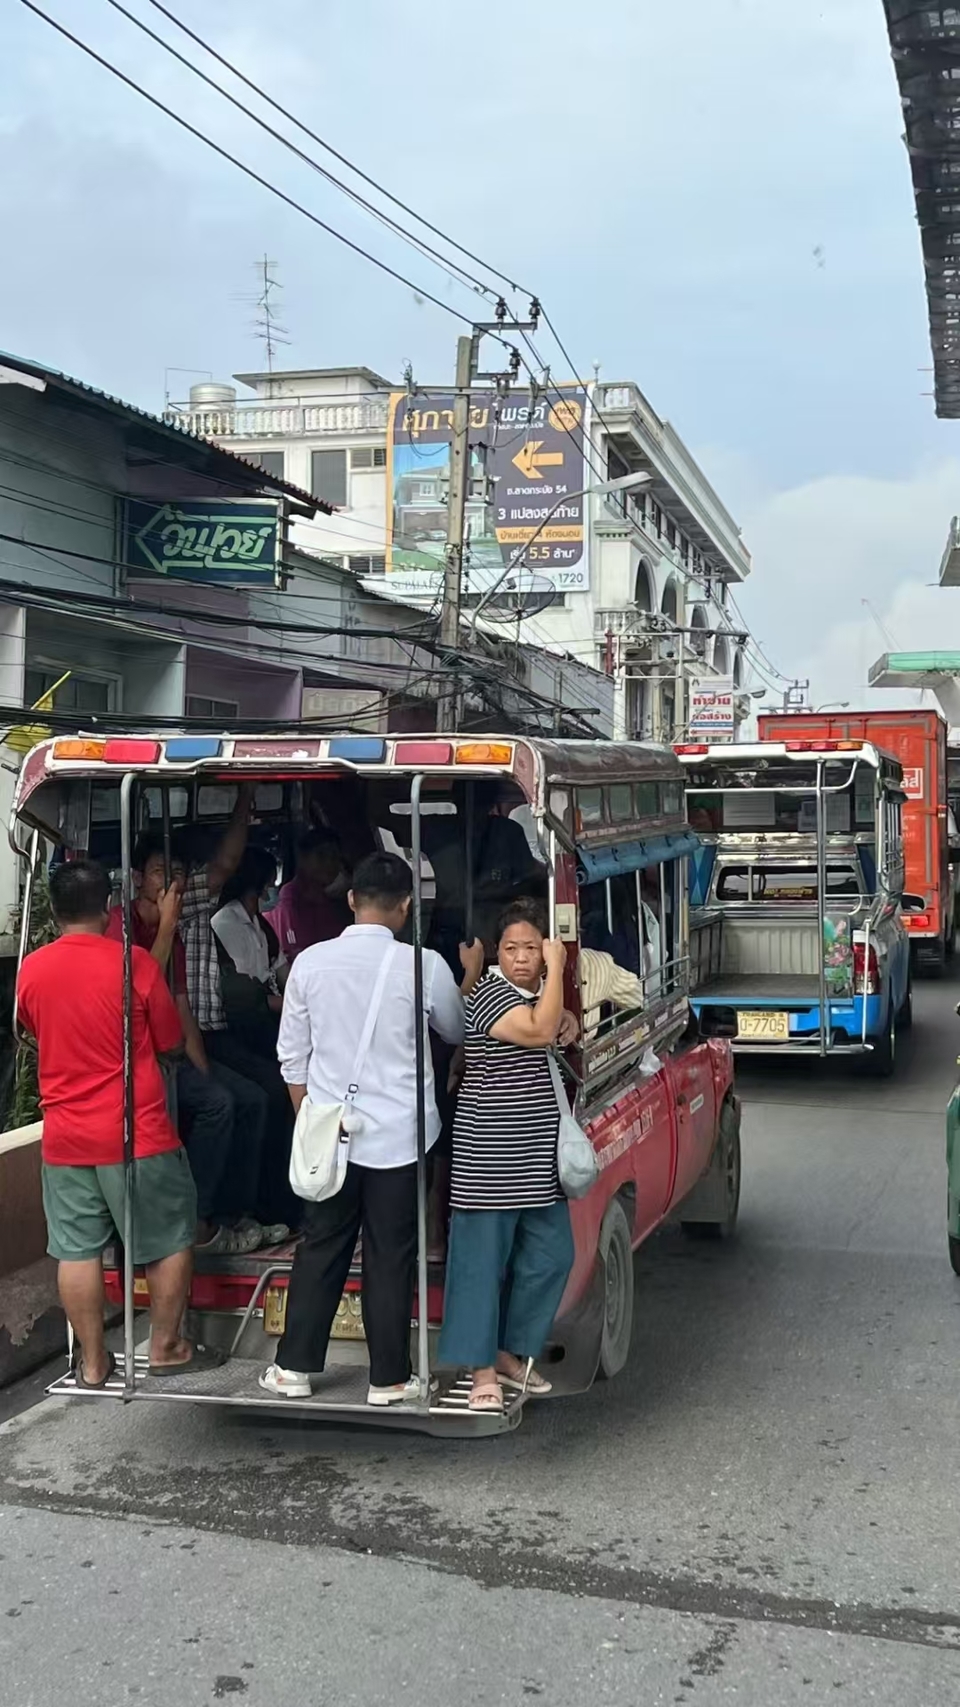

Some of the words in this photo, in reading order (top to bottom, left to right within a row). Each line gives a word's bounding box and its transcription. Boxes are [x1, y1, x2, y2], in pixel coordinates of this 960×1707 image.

[402, 405, 489, 438] ศุภาัย
[507, 485, 553, 496] ซ.ลาดกระบัง
[555, 485, 567, 494] 54
[497, 507, 506, 521] 3
[510, 505, 579, 520] แปลงสท้าย
[529, 546, 550, 560] 5.5
[558, 573, 584, 584] 1720
[692, 710, 732, 720] กอสร้าง
